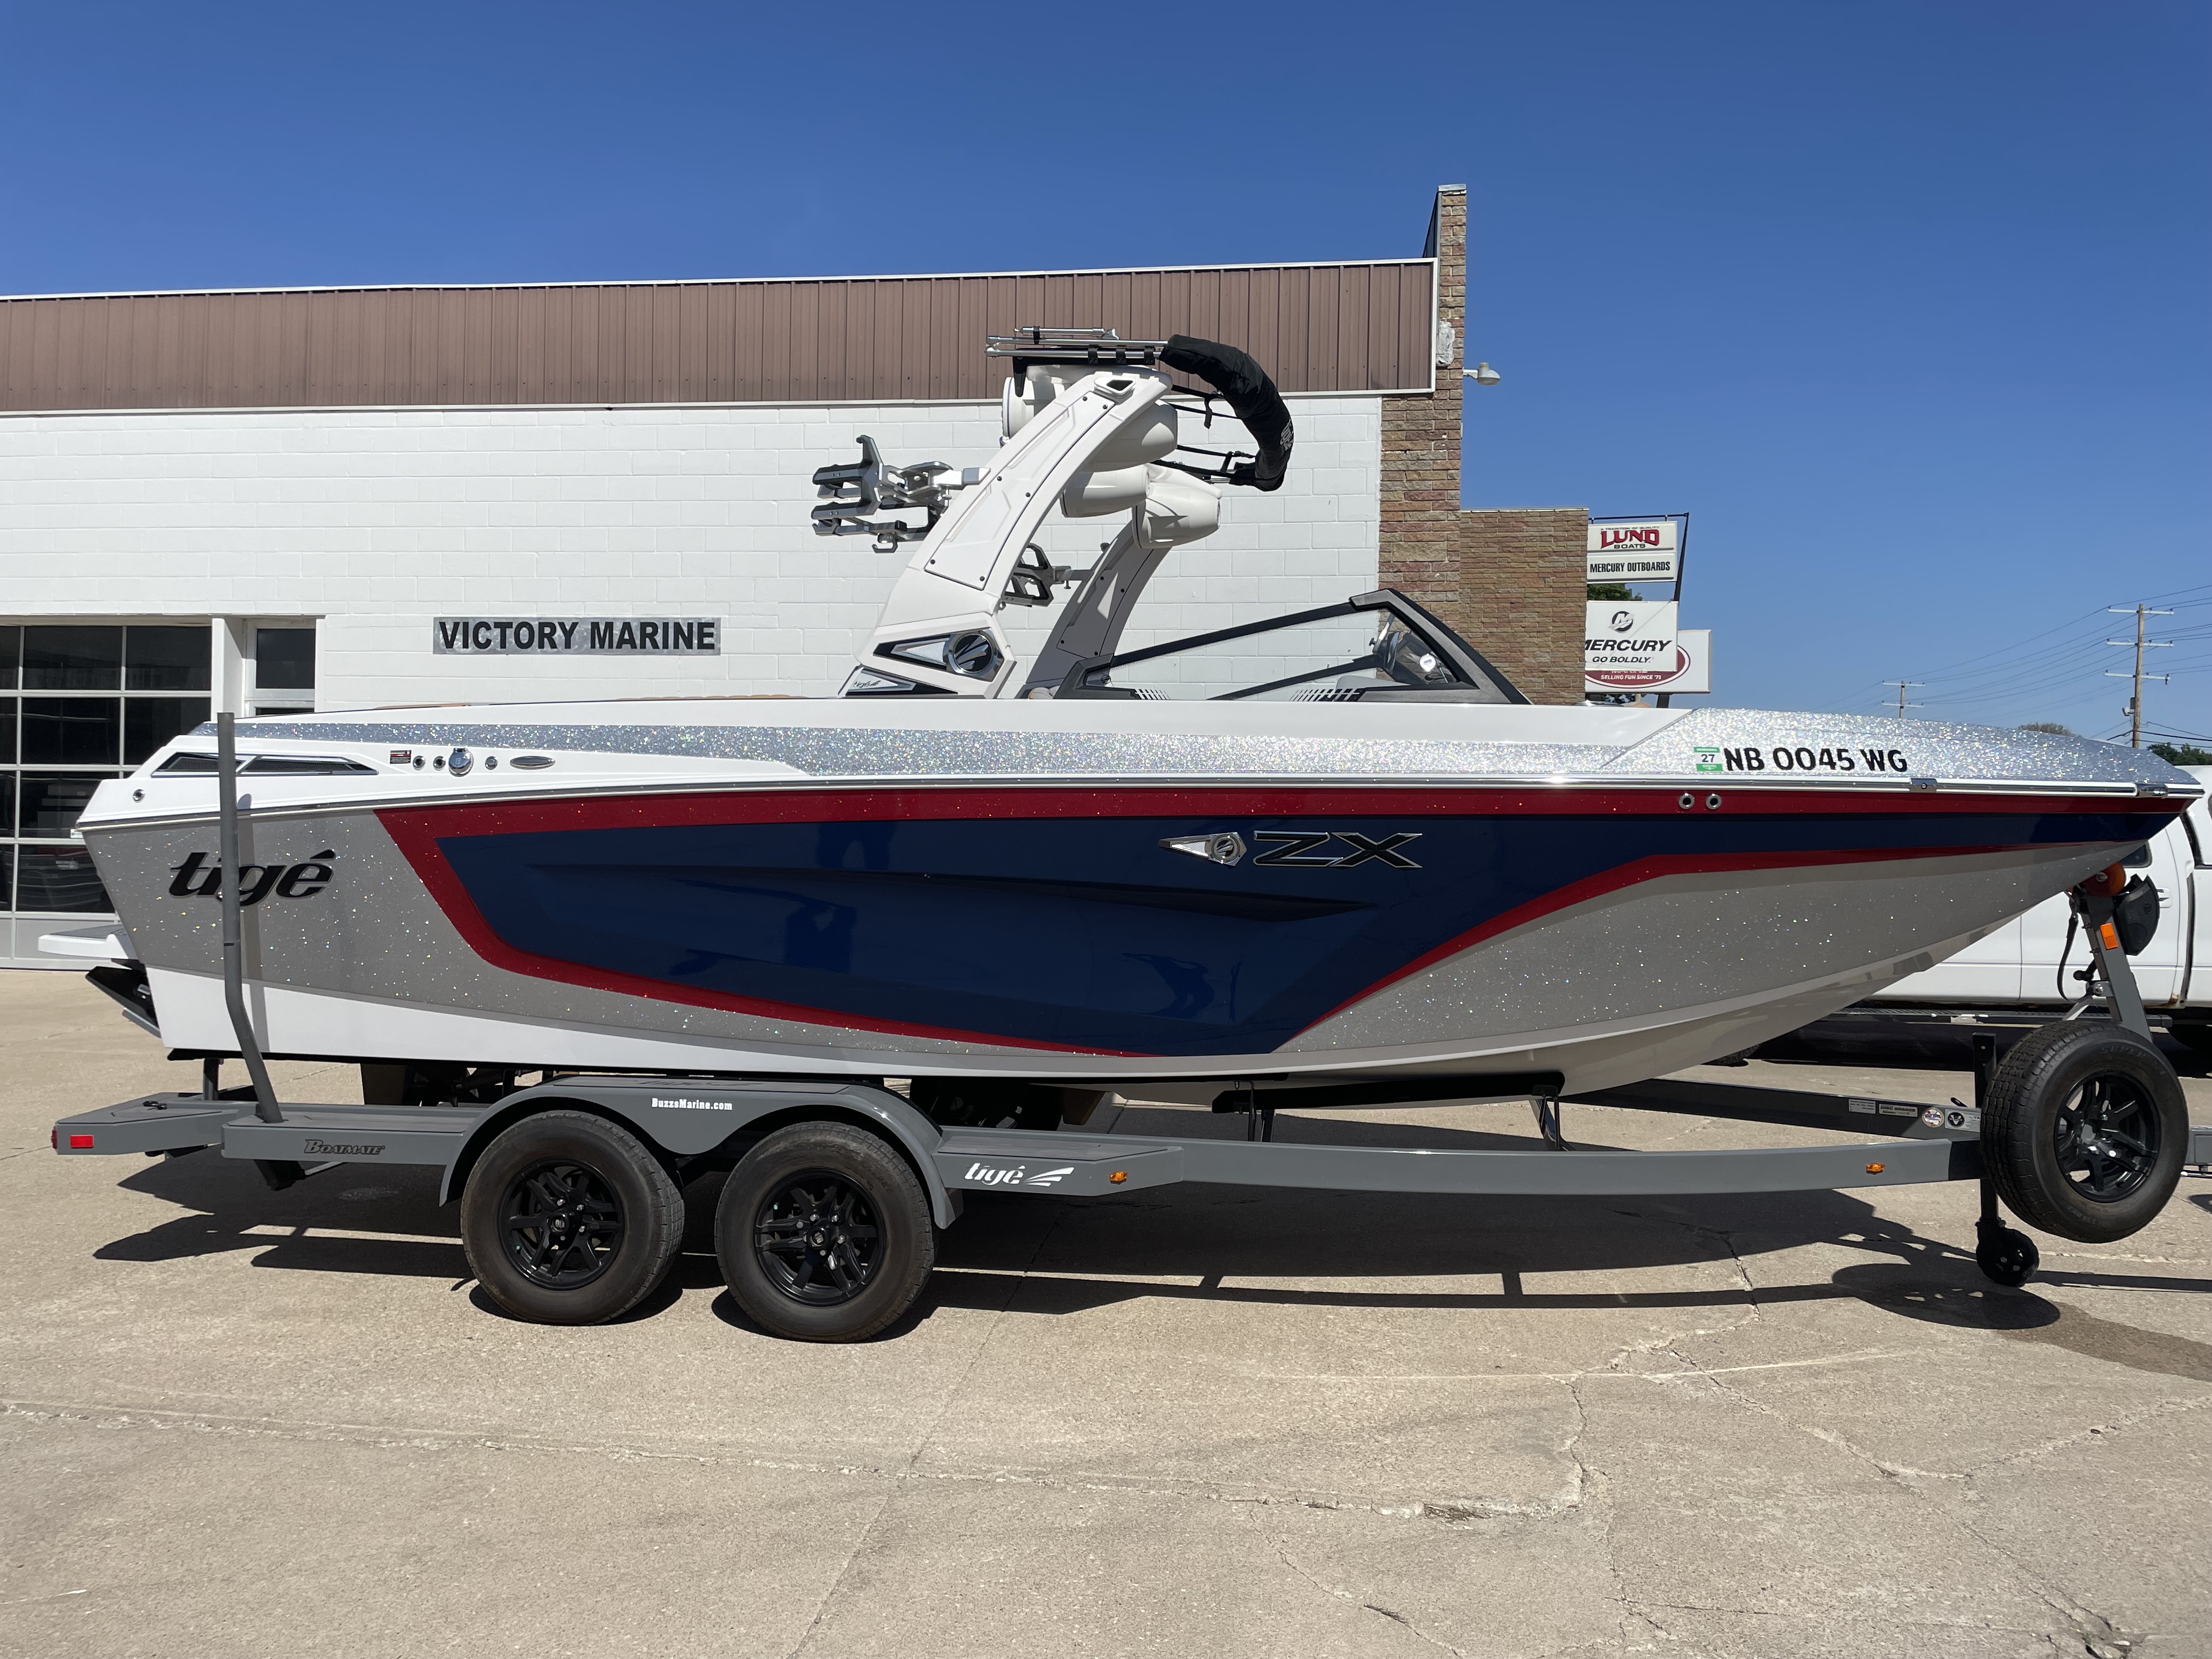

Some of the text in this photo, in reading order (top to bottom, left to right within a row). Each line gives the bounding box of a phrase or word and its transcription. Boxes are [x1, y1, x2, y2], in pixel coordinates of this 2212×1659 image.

[1600, 529, 1660, 549] LUND
[1590, 561, 1670, 573] MERCURY OUTBOARDS
[439, 621, 715, 650] VICTORY MARINE
[1701, 754, 1716, 763] 27
[1723, 747, 1908, 772] NB 0045 WG
[1253, 830, 1423, 868] ZX
[169, 849, 336, 907] tigé
[651, 1097, 733, 1110] BuzzsMarine.com
[304, 1139, 383, 1155] BOATMATE
[964, 1163, 1025, 1186] tigé
